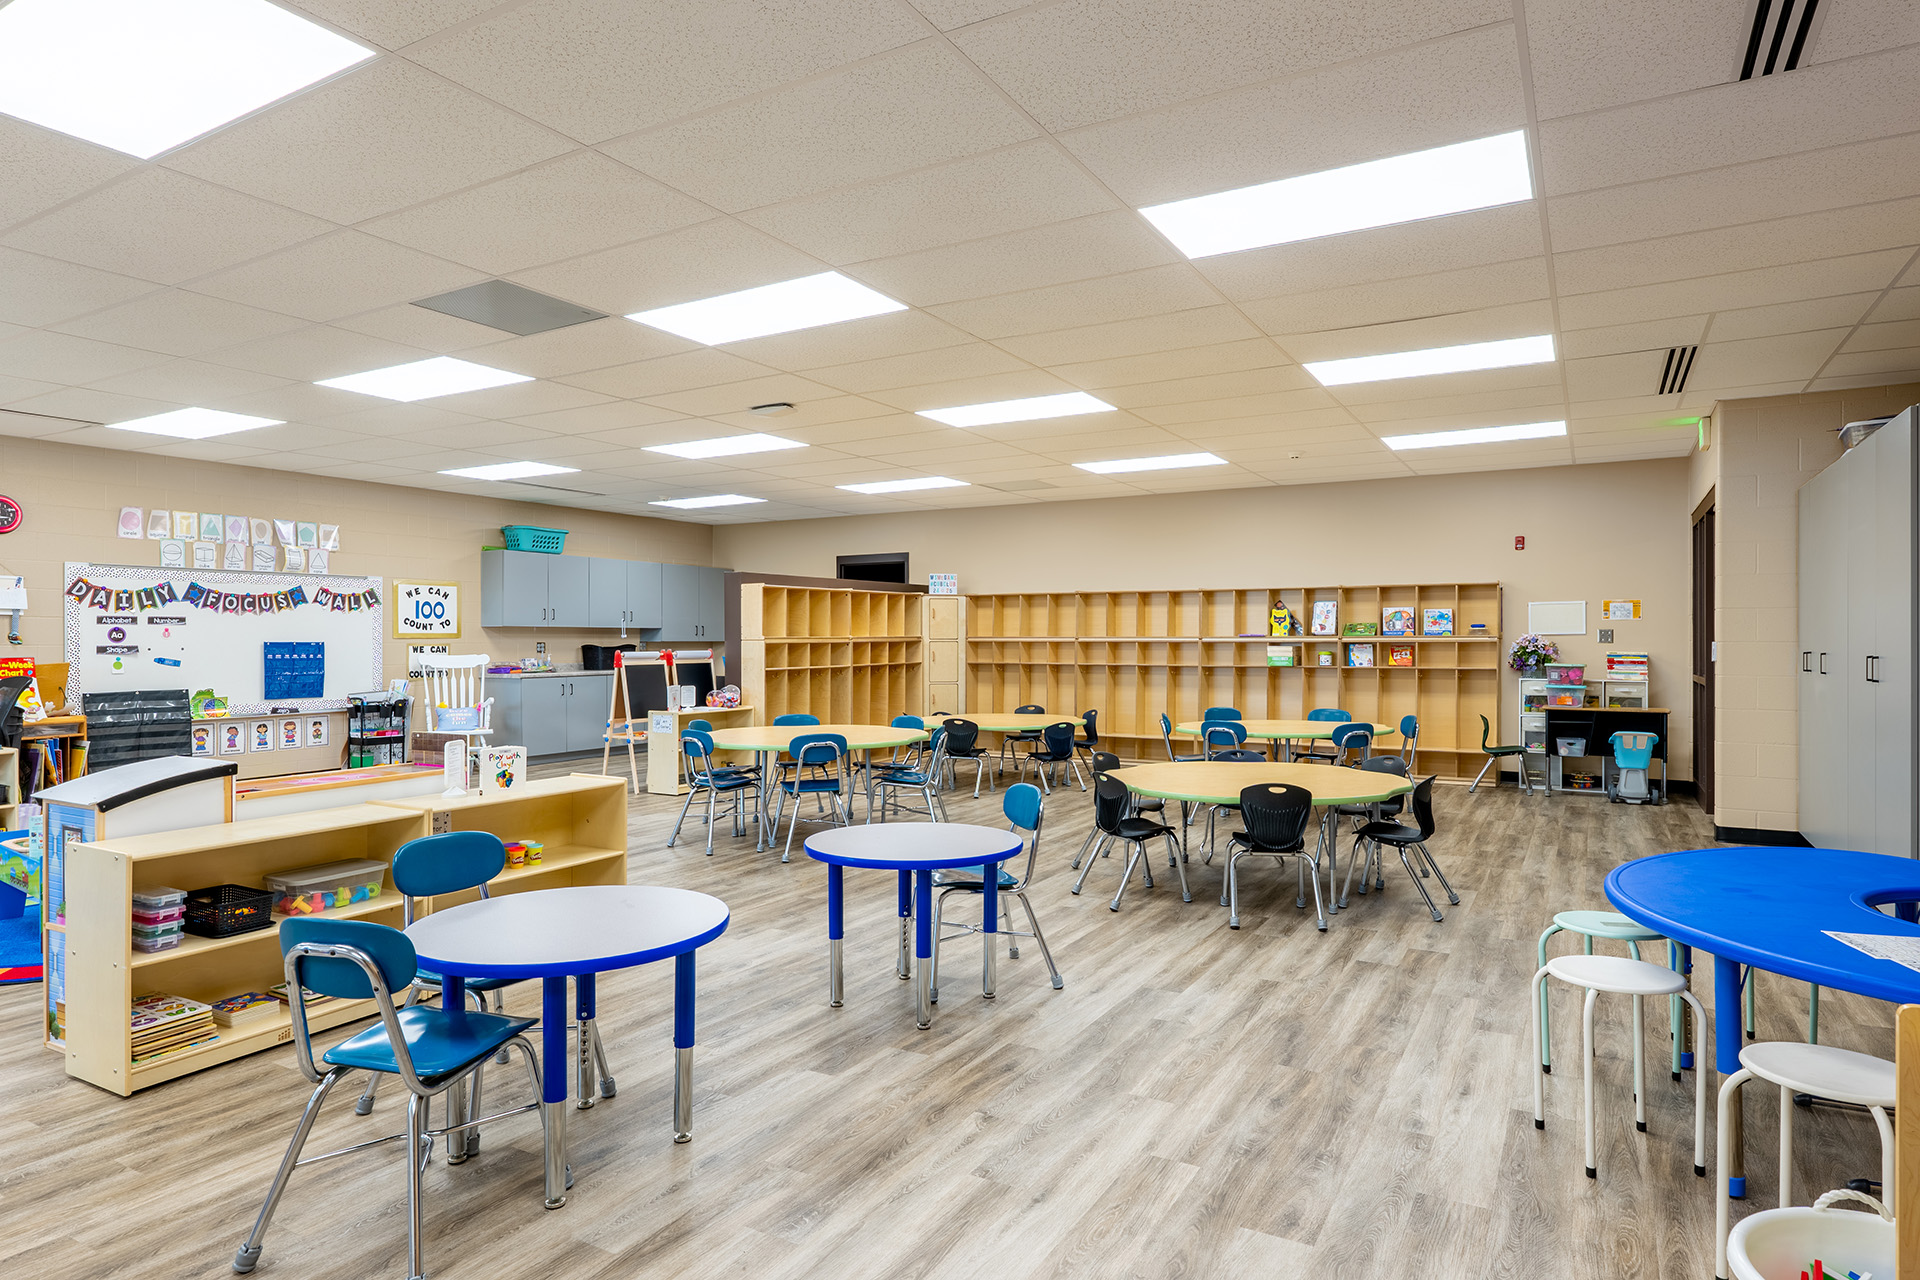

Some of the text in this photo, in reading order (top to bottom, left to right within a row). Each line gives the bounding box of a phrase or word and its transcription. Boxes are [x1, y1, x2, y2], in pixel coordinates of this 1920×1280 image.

[71, 585, 376, 610] DAILY FOCUS WALL
[406, 587, 450, 600] WE CAN
[415, 600, 445, 619] 100
[102, 616, 133, 625] Alphabet
[403, 617, 451, 631] COUNT TO
[110, 631, 123, 639] Aa
[106, 646, 128, 655] Shape
[0, 669, 24, 677] Chart
[488, 753, 504, 762] Play
[506, 752, 521, 760] with
[496, 760, 514, 769] Clay!
